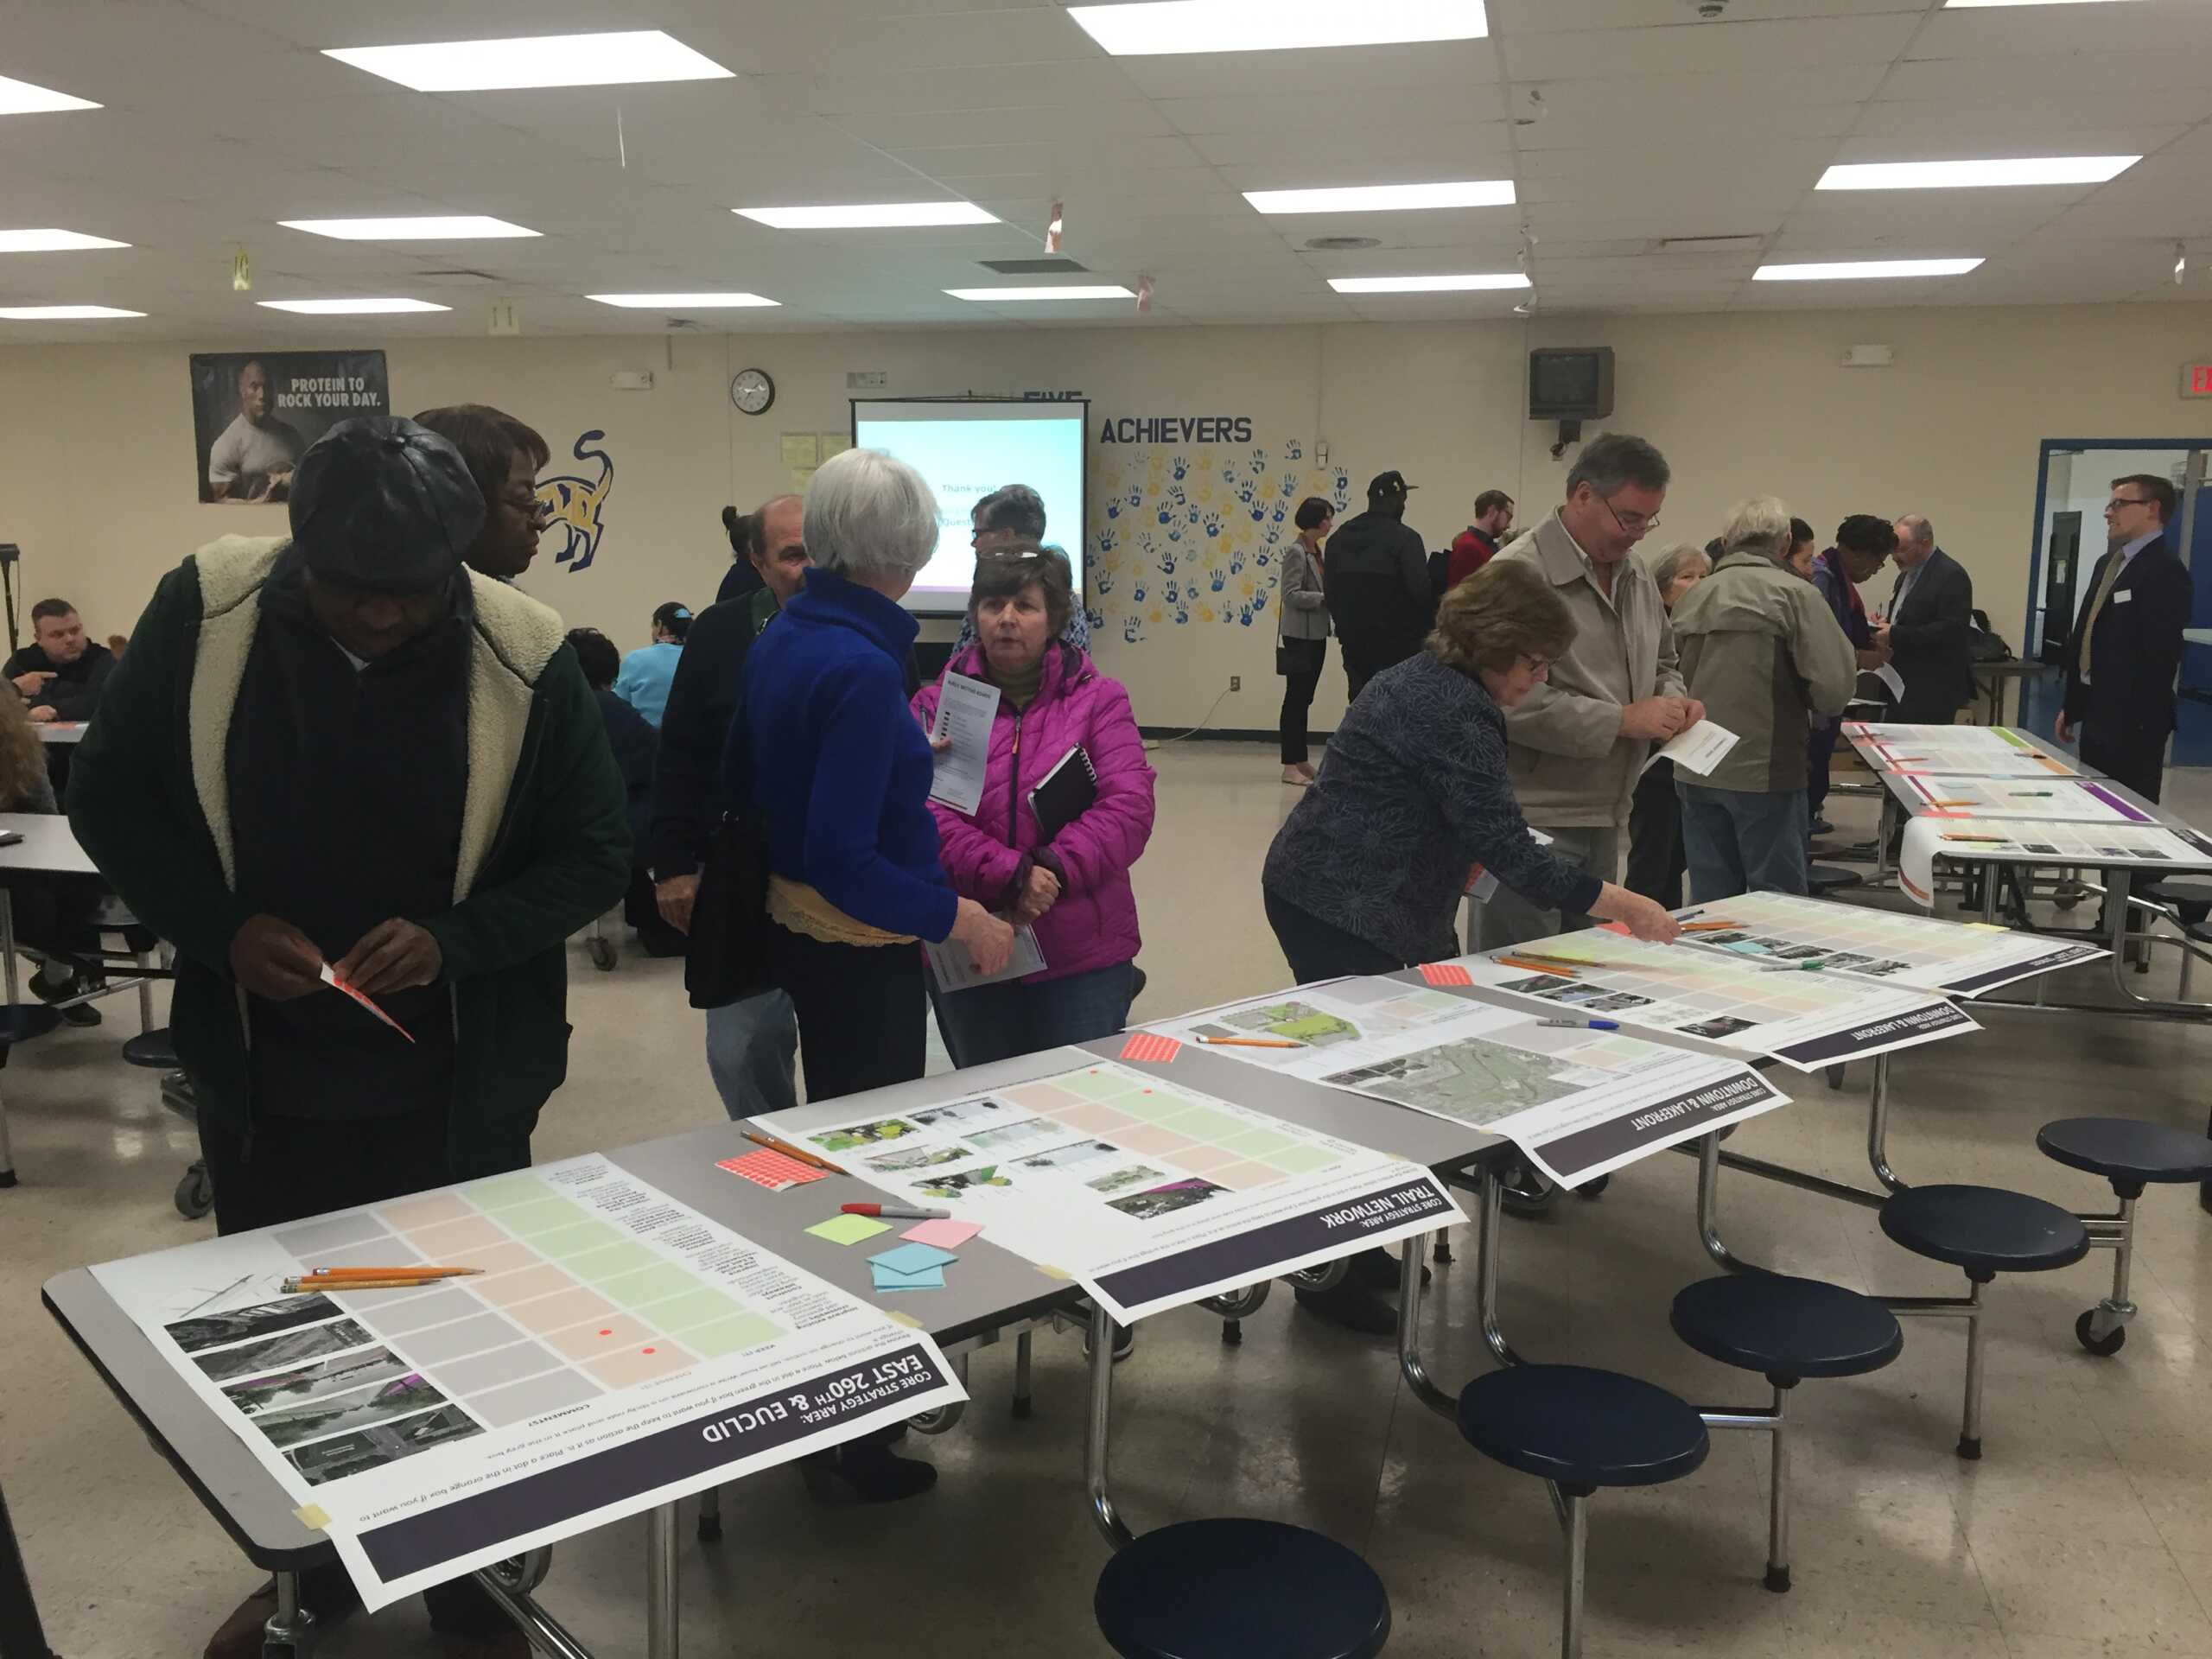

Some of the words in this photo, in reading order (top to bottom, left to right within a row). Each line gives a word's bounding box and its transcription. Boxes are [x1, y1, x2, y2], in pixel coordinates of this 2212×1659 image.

[290, 378, 346, 392] PROTEIN
[347, 377, 365, 391] TO
[277, 393, 313, 408] ROCK
[315, 392, 350, 407] YOUR
[352, 392, 381, 407] DAY.
[1100, 417, 1252, 443] ACHIEVERS
[942, 484, 972, 493] Thank
[1905, 1004, 1954, 1025] DOWNTOWN
[1896, 1017, 1908, 1028] &
[1851, 1021, 1897, 1040] LAKEFRONT
[1696, 1077, 1757, 1105] DOWNTOWN
[1686, 1097, 1700, 1110] &
[1631, 1101, 1689, 1130] LAKEFRONT
[1390, 1185, 1434, 1205] TRAIL
[1420, 1198, 1442, 1210] CORE
[1320, 1198, 1392, 1228] NETWORK
[1383, 1203, 1421, 1221] STRATEGY
[1359, 1215, 1384, 1228] AREA:
[872, 1354, 923, 1383] EAST
[899, 1370, 931, 1389] CORE
[718, 1391, 734, 1400] box
[734, 1382, 757, 1395] green
[815, 1372, 869, 1405] 260TH
[694, 1397, 710, 1408] you
[787, 1394, 810, 1411] &
[840, 1384, 897, 1411] STRATEGY
[528, 1404, 590, 1427] COMMENTS?
[672, 1404, 694, 1416] want
[800, 1404, 836, 1423] AREA:
[626, 1423, 640, 1432] the
[640, 1415, 662, 1426] keep
[702, 1402, 787, 1442] EUCLID
[596, 1428, 624, 1441] action
[539, 1448, 563, 1460] Place
[512, 1460, 529, 1470] dot
[485, 1470, 501, 1479] the
[449, 1476, 483, 1491] orange
[420, 1494, 428, 1503] if
[429, 1488, 448, 1497] box
[399, 1497, 418, 1508] you
[372, 1505, 398, 1518] want
